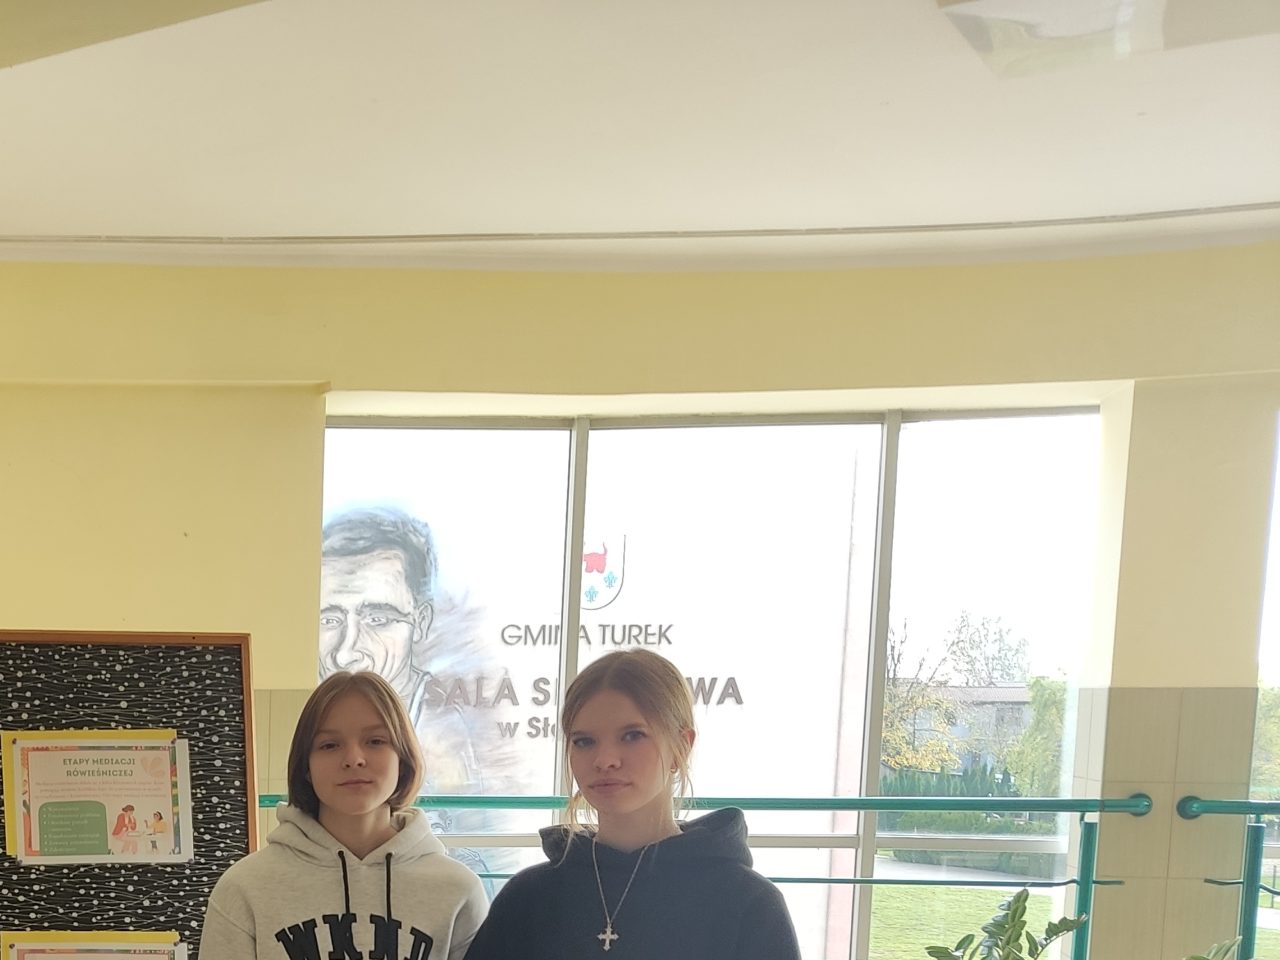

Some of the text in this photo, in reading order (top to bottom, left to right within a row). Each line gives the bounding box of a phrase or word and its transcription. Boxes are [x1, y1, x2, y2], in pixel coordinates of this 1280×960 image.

[599, 623, 674, 646] TUREK
[423, 676, 520, 706] SALA
[62, 758, 136, 766] ETAPY MEDIACJI
[66, 768, 134, 777] RÓWIEŚNICZEJ
